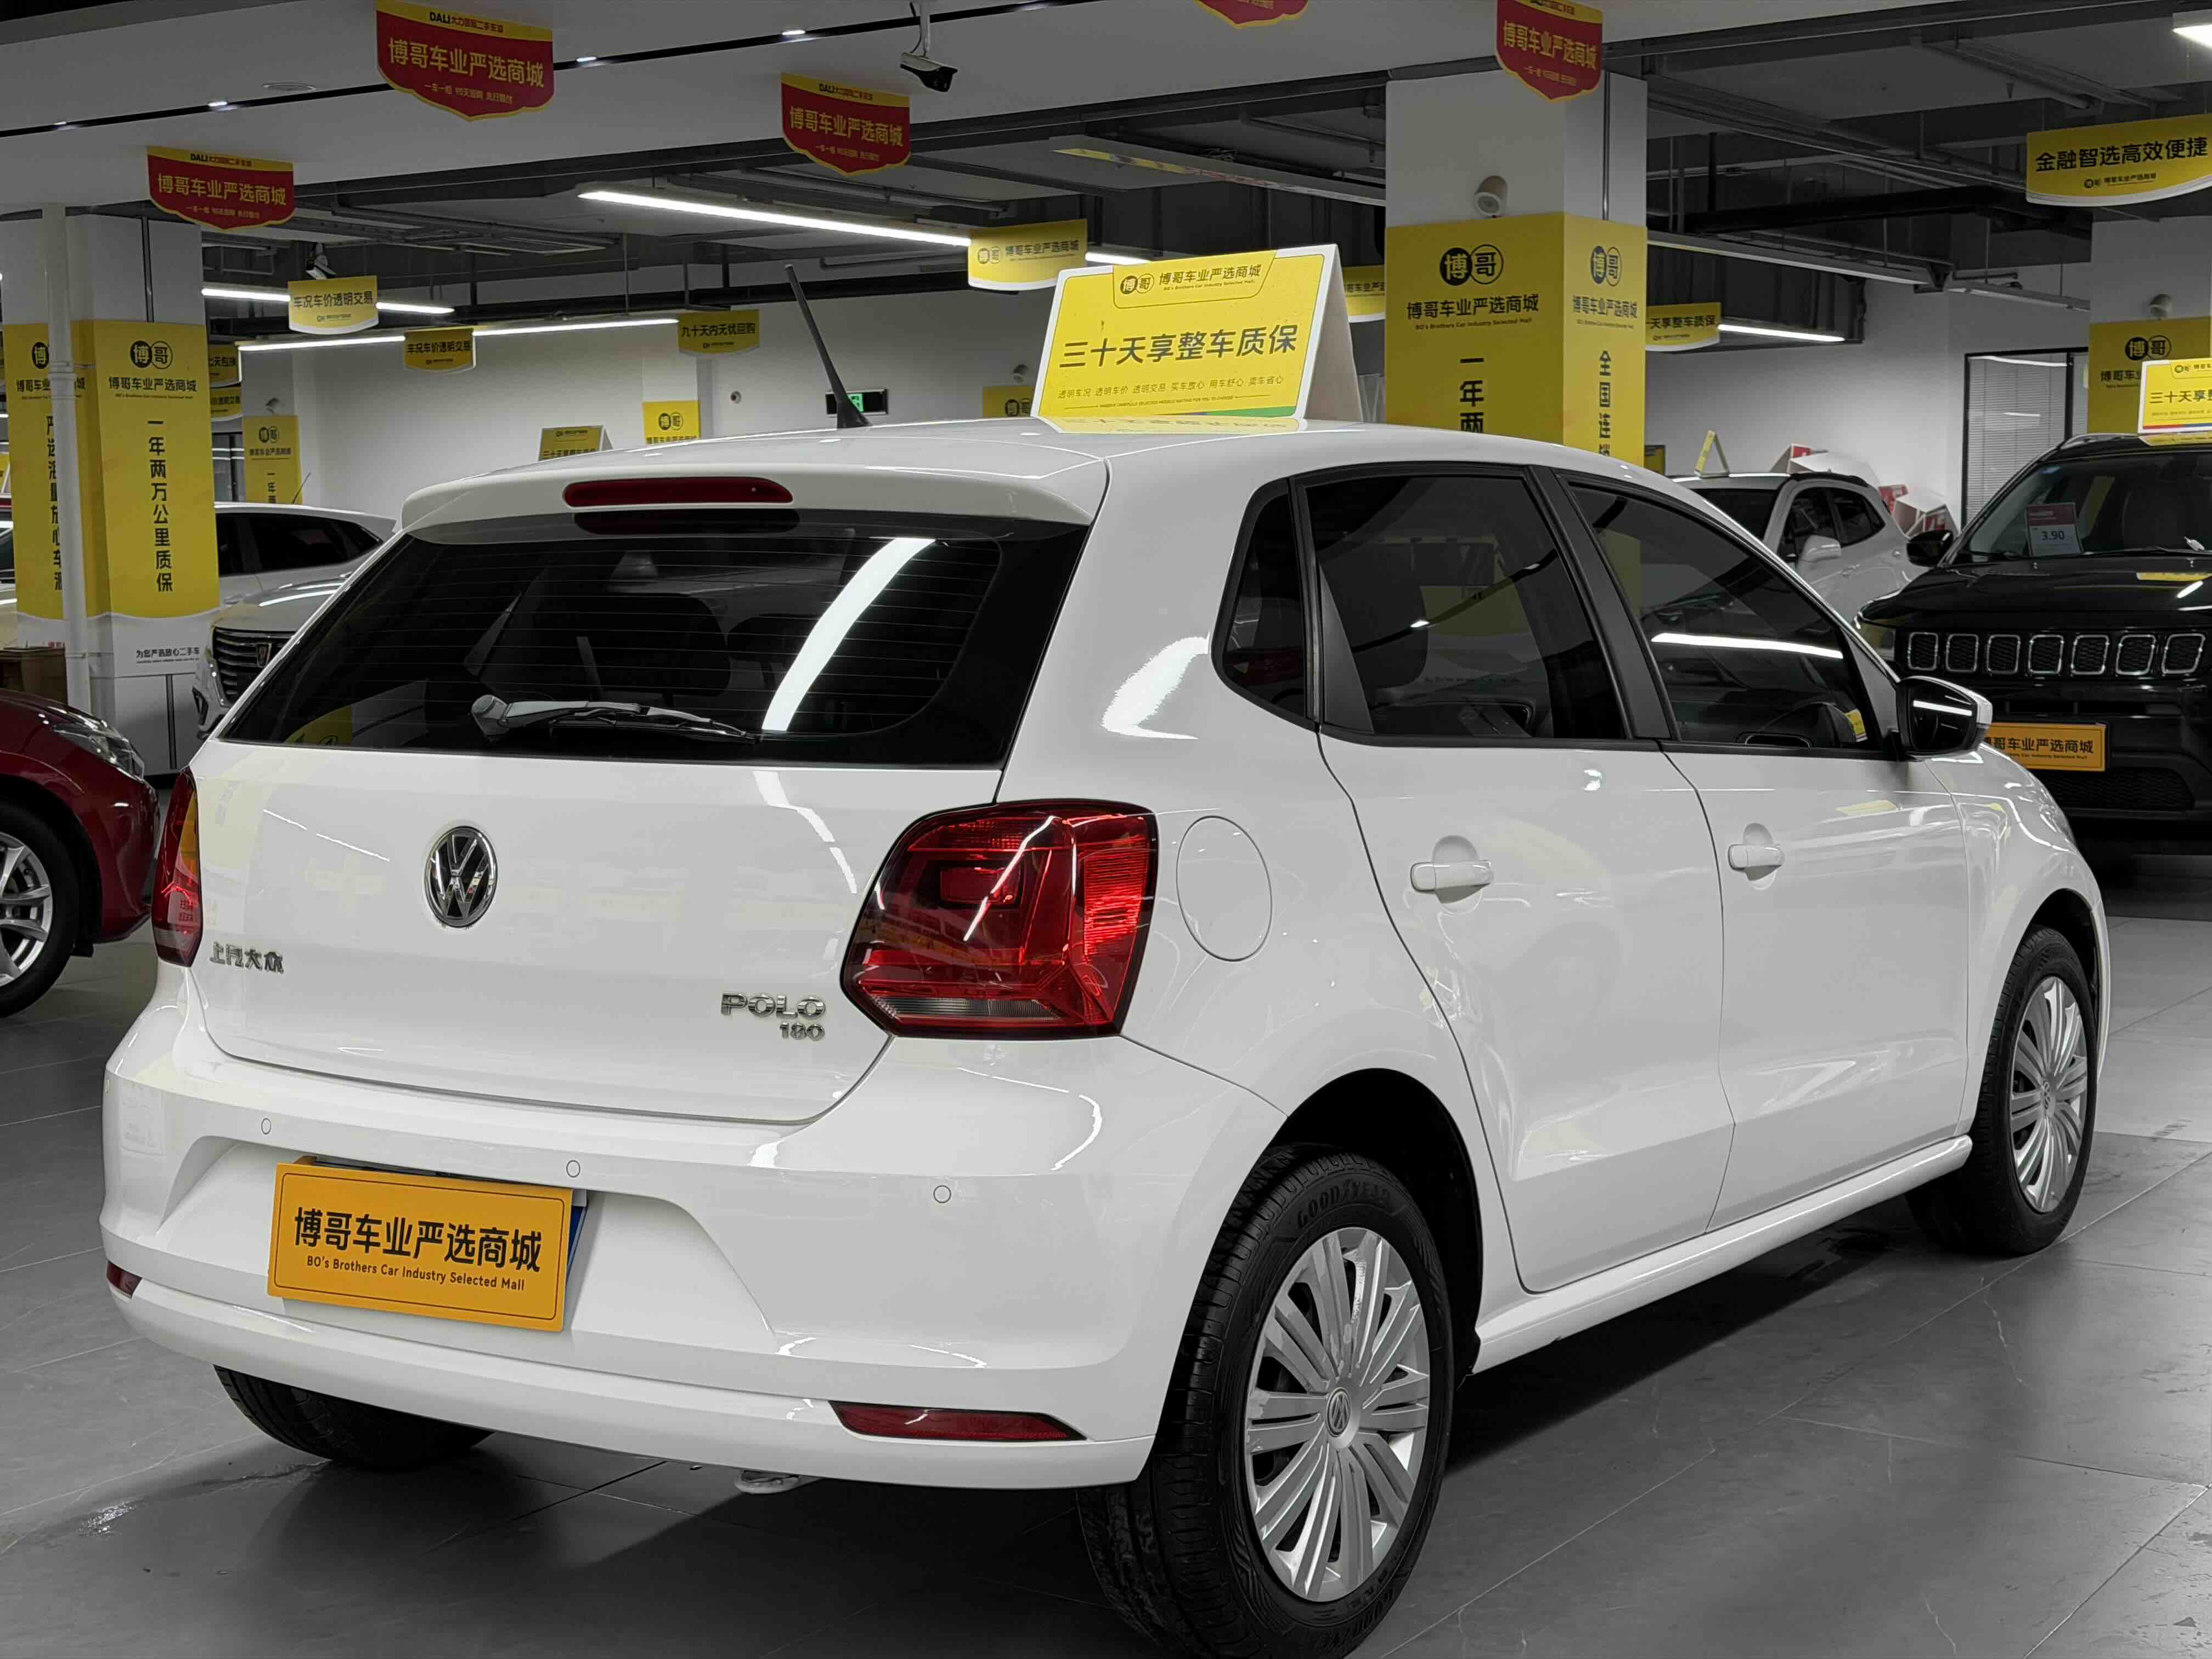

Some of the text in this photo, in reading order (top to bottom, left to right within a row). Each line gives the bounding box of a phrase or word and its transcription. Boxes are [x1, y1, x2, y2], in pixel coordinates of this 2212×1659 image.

[430, 12, 450, 24] DALI
[388, 37, 544, 88] 博哥车业严选商城
[790, 106, 903, 146] 博哥车业严选商城
[2035, 137, 2208, 172] 金融智选高效便捷
[157, 173, 286, 206] 博哥车业严选商城
[1122, 264, 1261, 293] 博哥 博哥车业严选商城
[1444, 250, 1498, 281] 博哥
[1592, 253, 1619, 282] 博哥
[294, 291, 373, 308] 车况车价透明交易
[1407, 294, 1539, 320] 博哥车业严选商城
[681, 322, 755, 337] 九十天内无忧回购
[133, 345, 170, 365] 博哥
[1059, 324, 1299, 369] 三十天享整车质保
[2129, 339, 2166, 358] 博哥
[109, 376, 197, 392] 博哥车业严选商城
[147, 420, 173, 592] 一年两万公里质保
[2041, 531, 2065, 540] 3.90
[210, 941, 284, 974] 上汽大众
[720, 992, 826, 1019] POLO
[779, 1022, 825, 1041] 180
[294, 1206, 542, 1273] 博哥车业严选商城
[306, 1255, 525, 1291] BO's Brothers Car Industry Selected Mall
